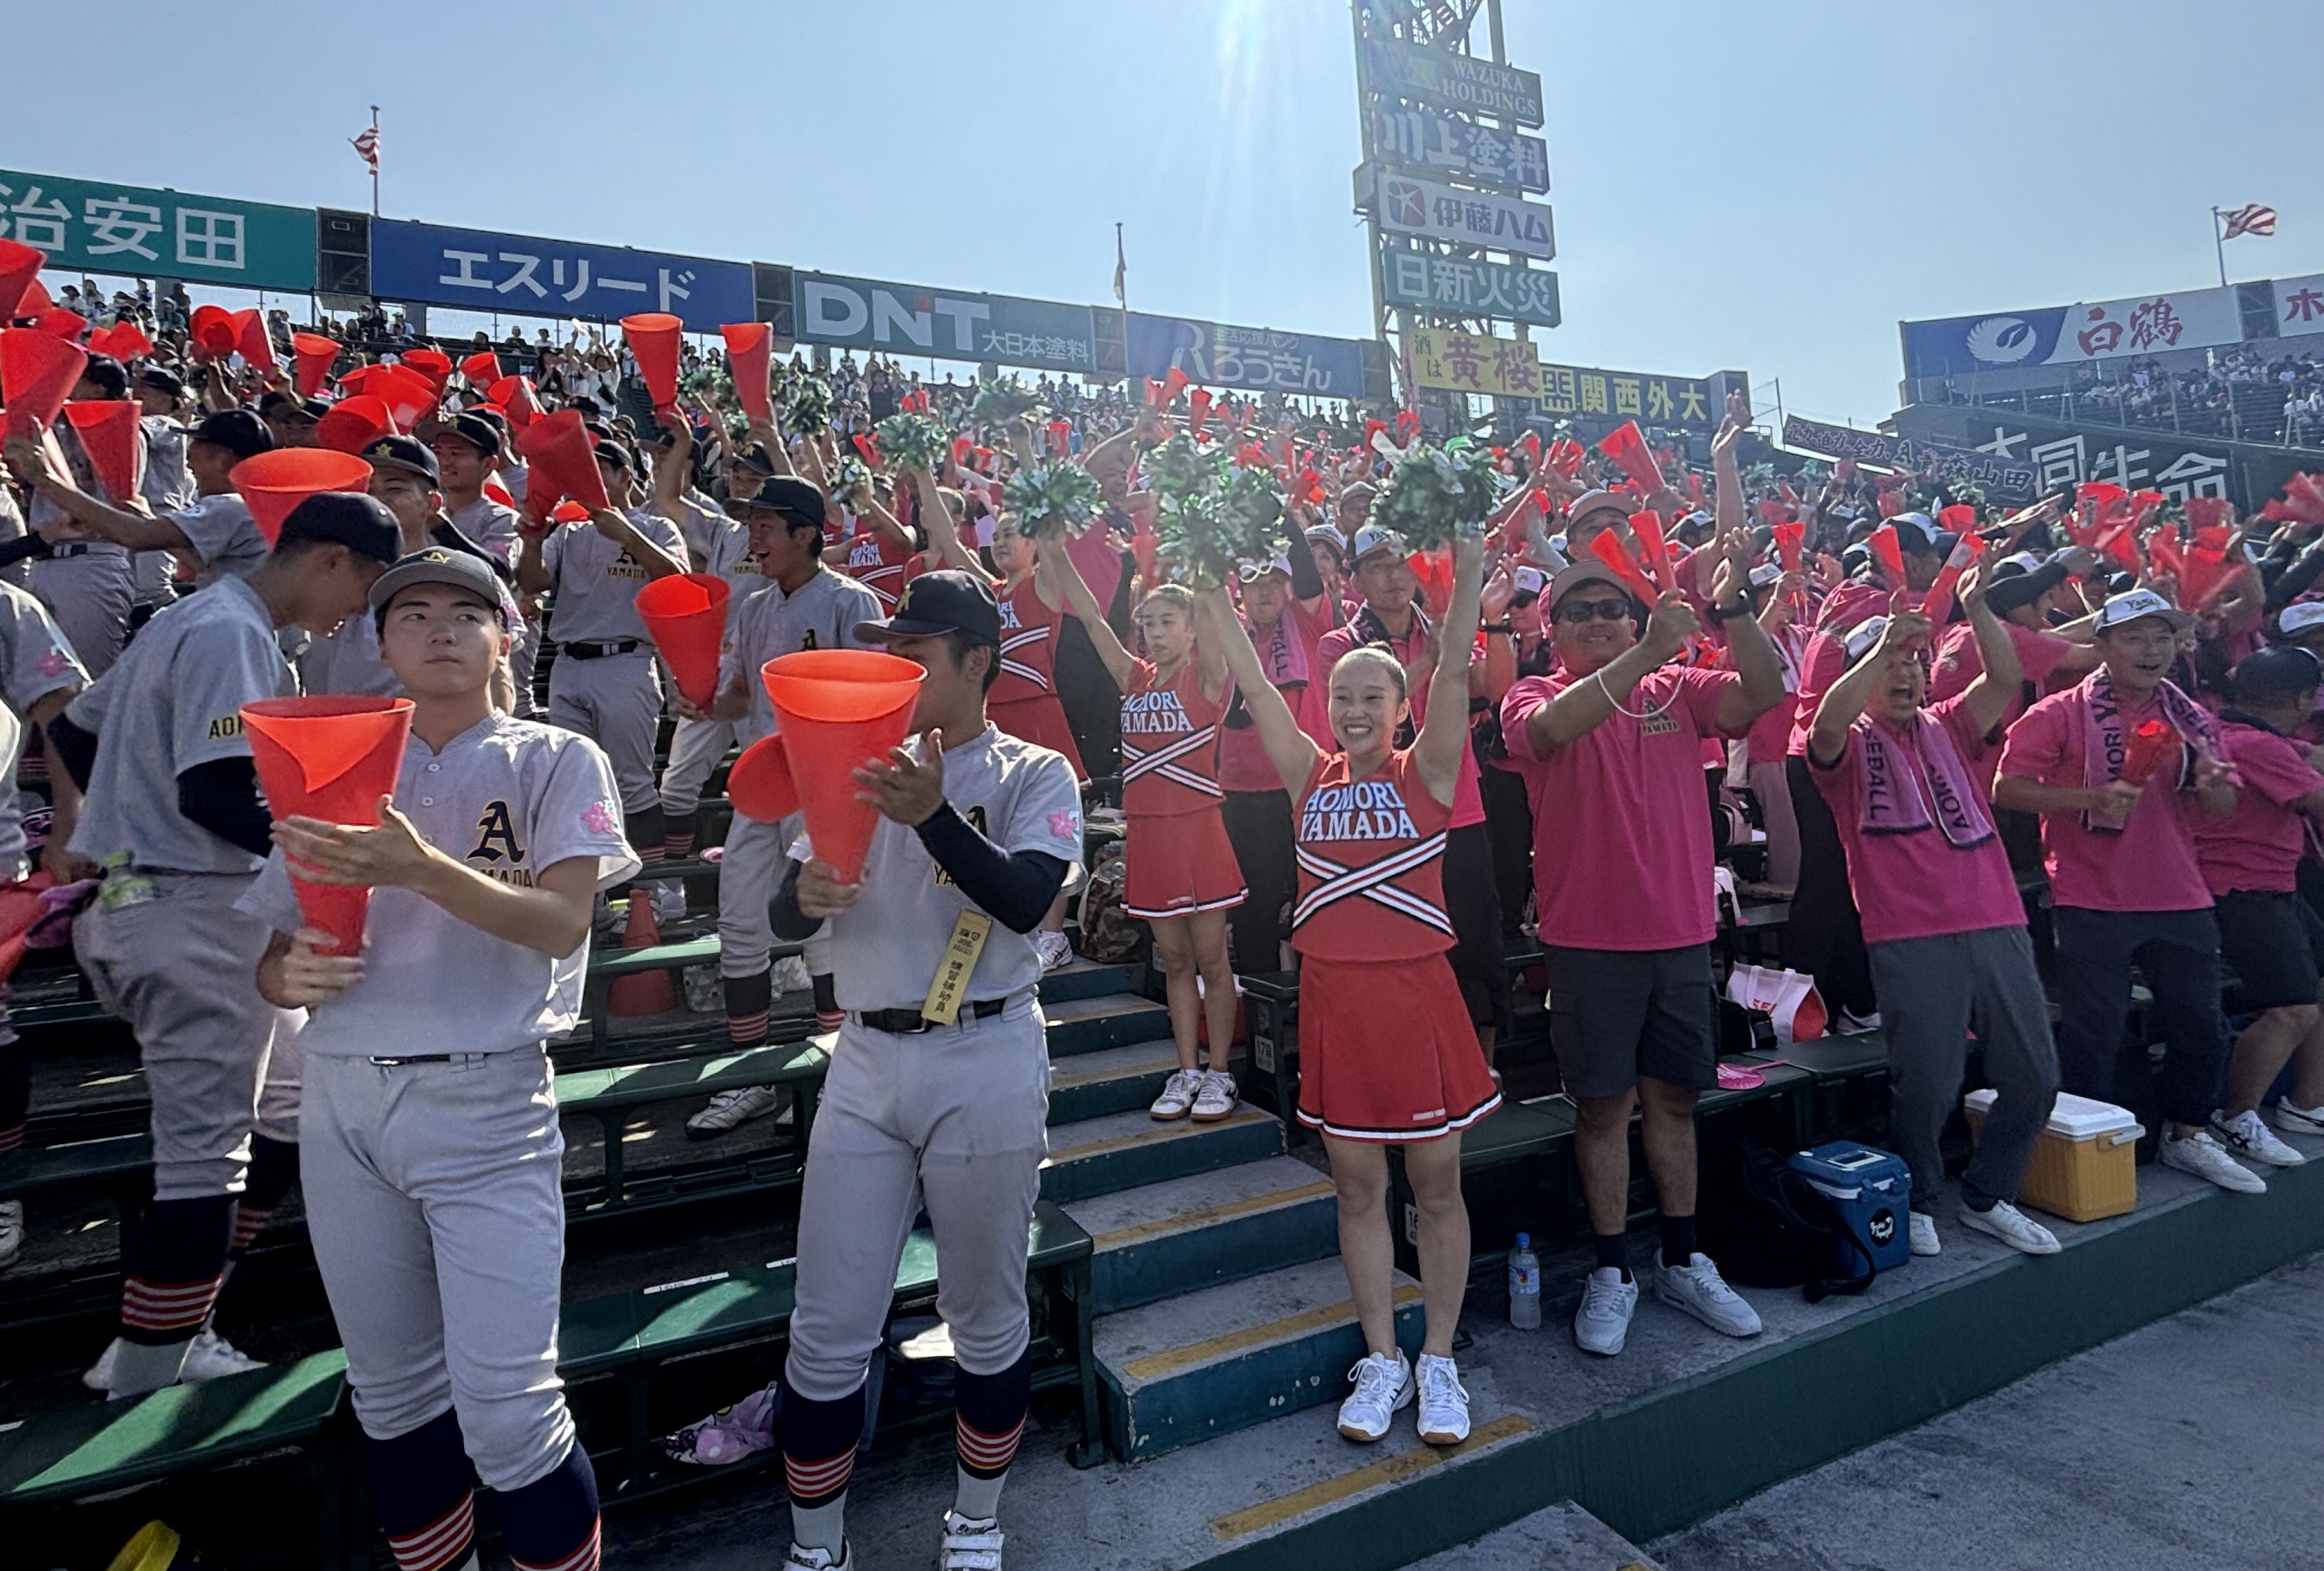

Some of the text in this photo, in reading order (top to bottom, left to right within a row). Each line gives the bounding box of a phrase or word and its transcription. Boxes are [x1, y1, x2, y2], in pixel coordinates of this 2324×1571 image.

[1442, 79, 1538, 117] HOLDINGS
[1451, 59, 1525, 94] WAZUKA
[1382, 112, 1545, 187] 川上塗料
[1433, 198, 1550, 244] 伊藤ハム
[439, 249, 696, 312] エスリード
[1396, 252, 1552, 317] 日新火災
[804, 280, 991, 352] DNT
[2077, 297, 2184, 356] 白鶴
[982, 329, 1089, 364] 大日本塗料
[1212, 345, 1332, 391] ろうきん
[1441, 336, 1540, 394] 黄桜
[1580, 373, 1707, 421] 関西外大
[1304, 781, 1407, 813] AOMORI
[464, 799, 527, 865] A
[1298, 809, 1420, 843] YAMADA
